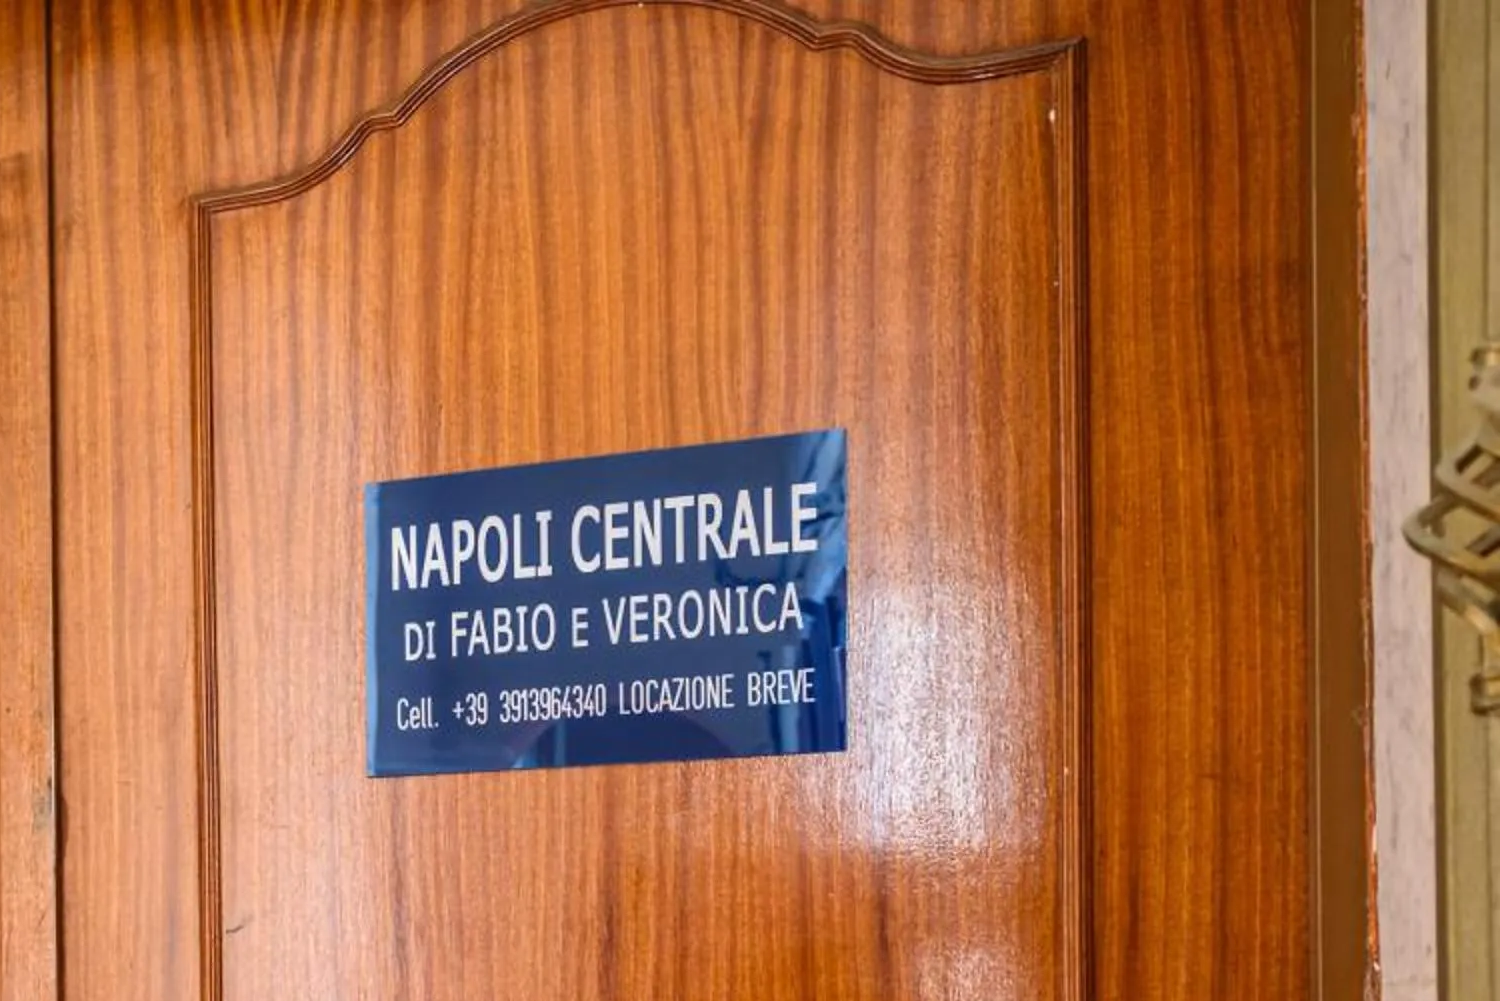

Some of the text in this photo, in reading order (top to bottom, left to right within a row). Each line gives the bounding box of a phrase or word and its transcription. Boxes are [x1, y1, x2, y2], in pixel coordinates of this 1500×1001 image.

[391, 482, 818, 591] NAPOLI CENTRALE
[404, 581, 804, 662] DI FABIO E VERONICA
[396, 667, 816, 731] Cell. +39 3913964340 LOCAZIONE BREVE
